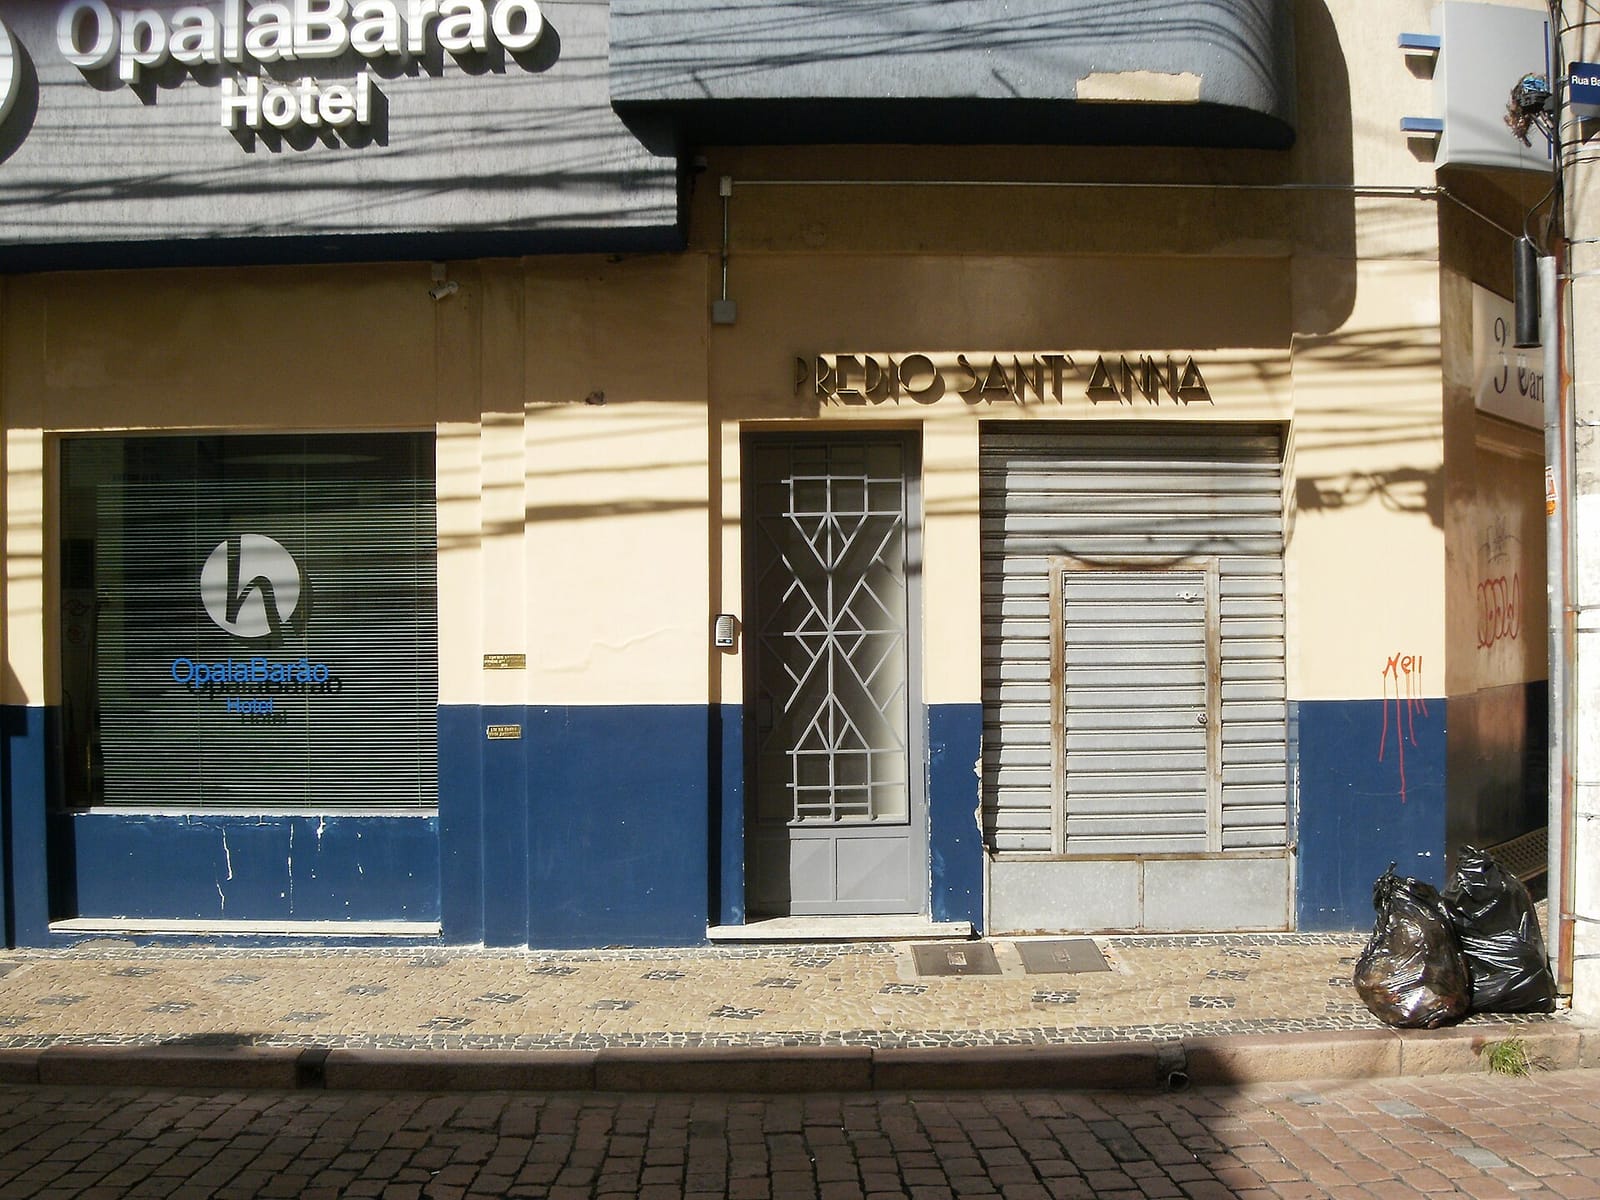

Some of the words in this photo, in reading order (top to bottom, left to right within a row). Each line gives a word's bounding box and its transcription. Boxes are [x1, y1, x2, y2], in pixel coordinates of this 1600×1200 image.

[1571, 75, 1589, 86] Rua
[221, 72, 371, 129] Hotel
[171, 656, 330, 689] OpalaBarão
[226, 697, 274, 714] Hotel
